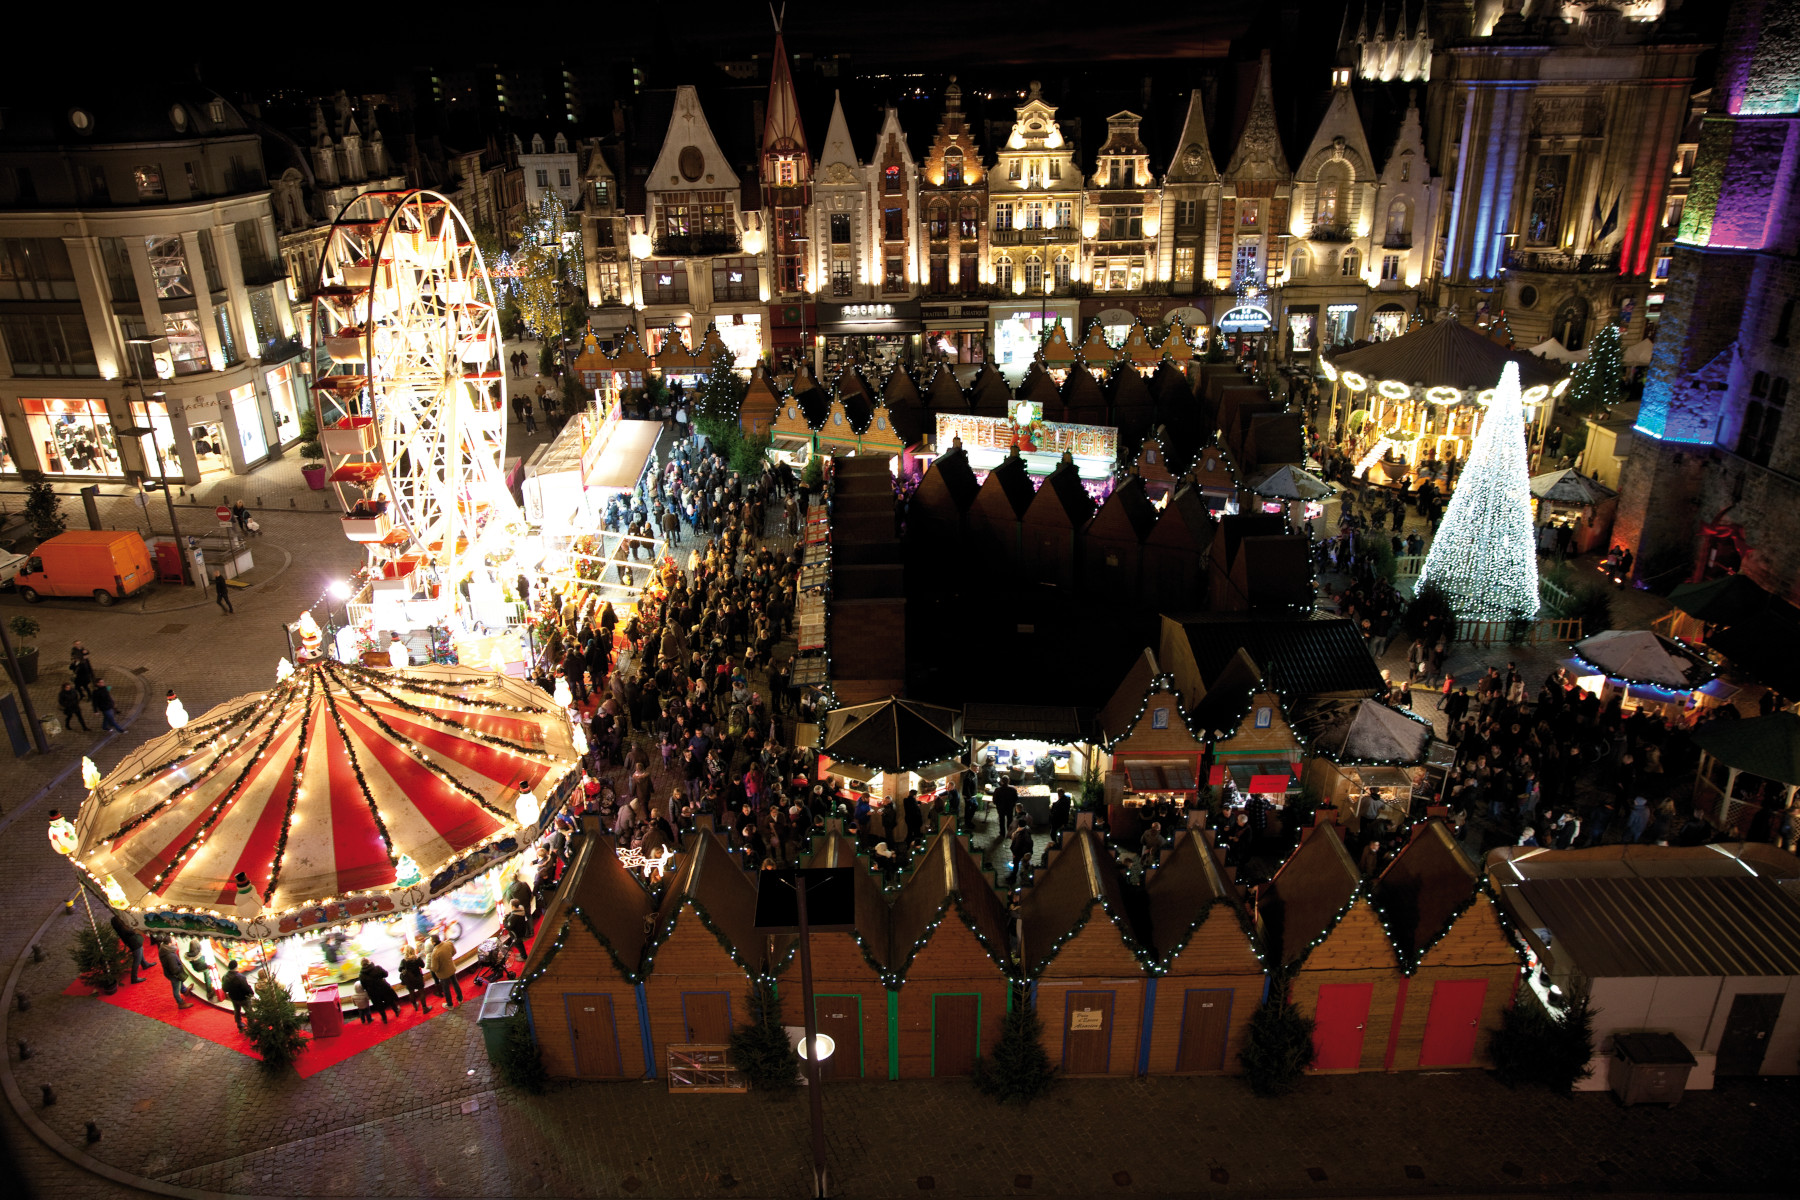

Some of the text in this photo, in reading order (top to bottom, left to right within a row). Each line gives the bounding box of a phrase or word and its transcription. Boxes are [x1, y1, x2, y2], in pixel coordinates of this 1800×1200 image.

[841, 304, 896, 318] FACTORY PUB
[962, 308, 987, 316] ASIATIQUE
[1042, 429, 1113, 456] MAGIC
